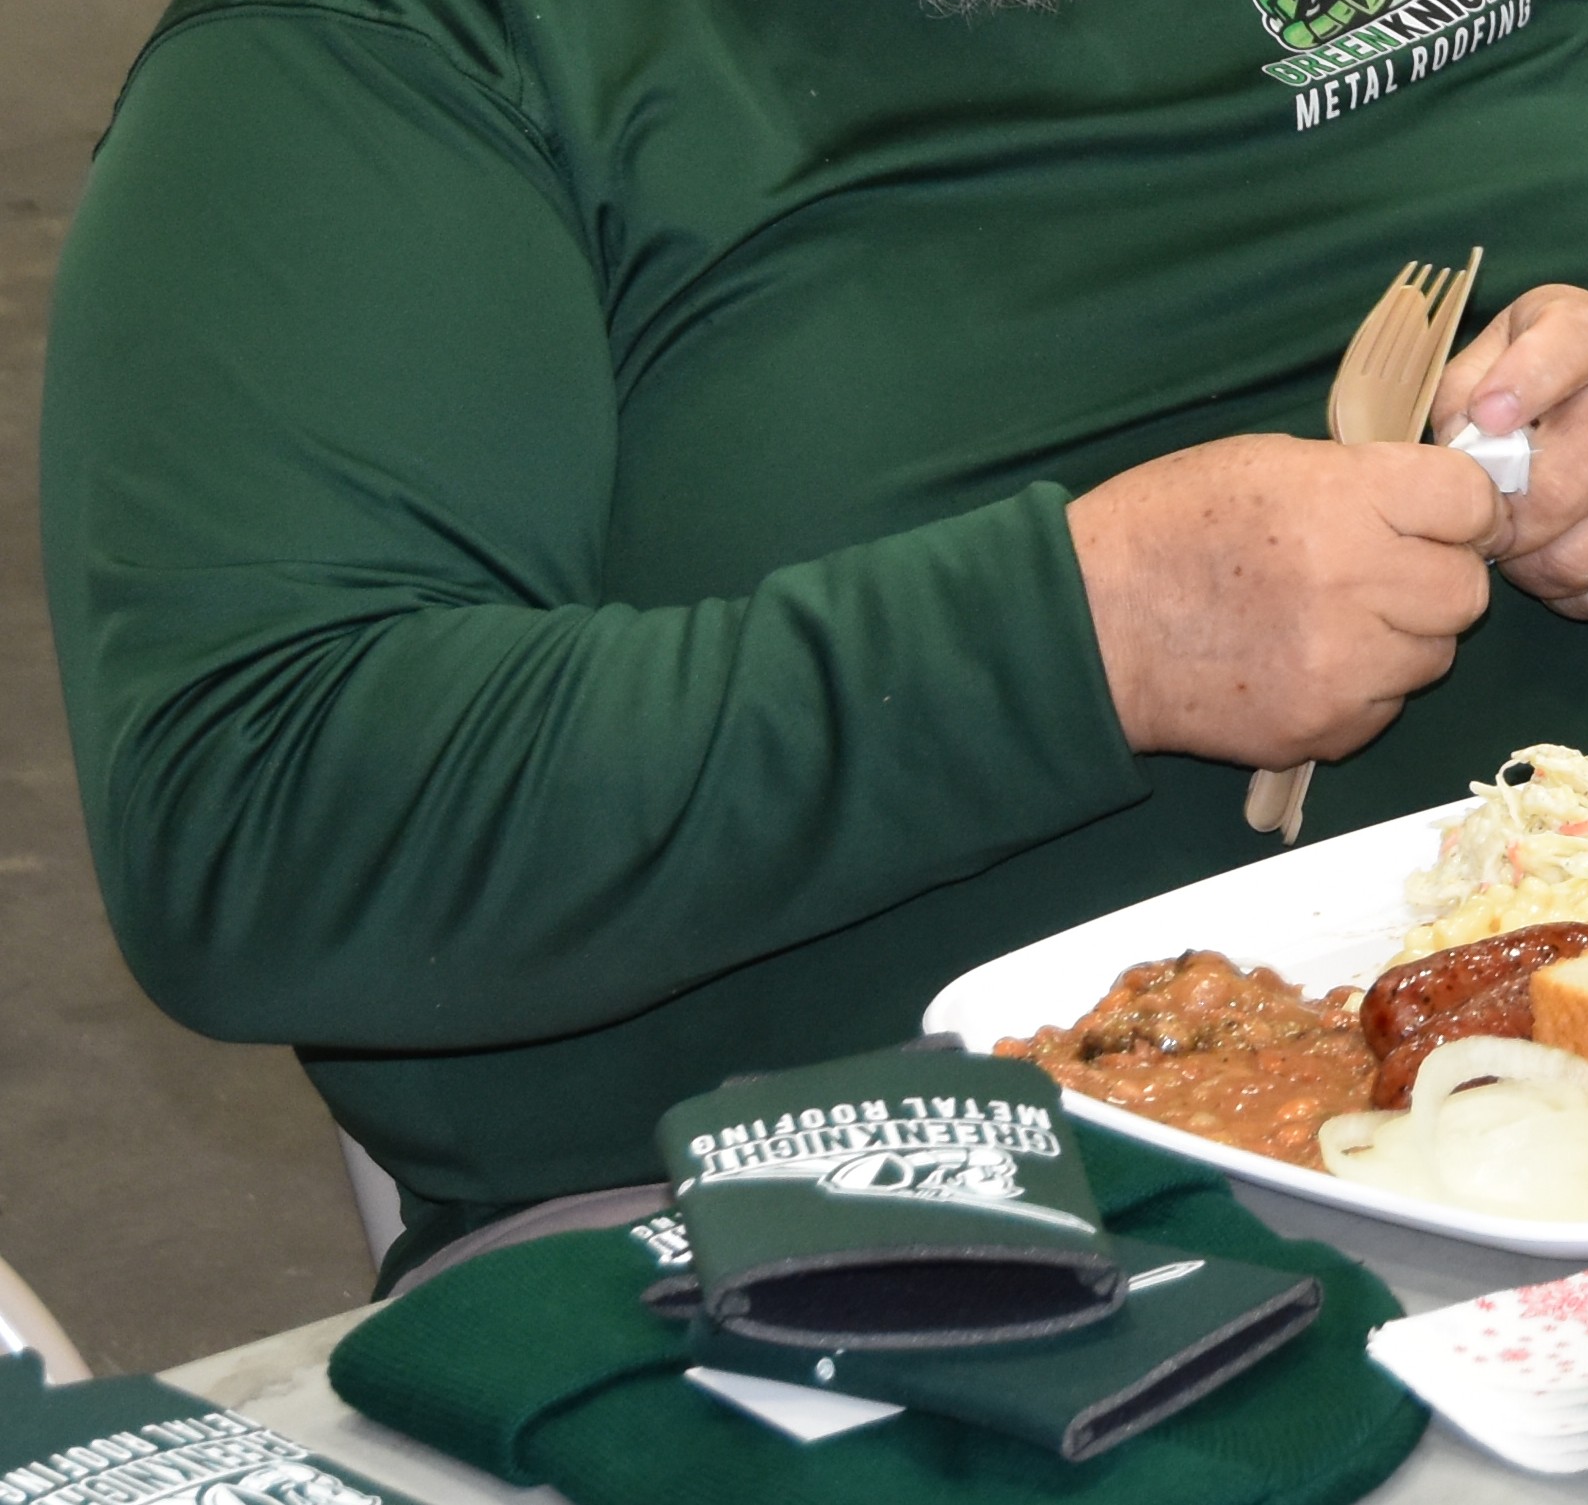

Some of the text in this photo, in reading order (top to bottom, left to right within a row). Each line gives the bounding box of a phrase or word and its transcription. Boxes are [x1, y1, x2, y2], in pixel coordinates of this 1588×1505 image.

[1295, 59, 1398, 131] METAL
[689, 1096, 1052, 1156] METAL ROOFING
